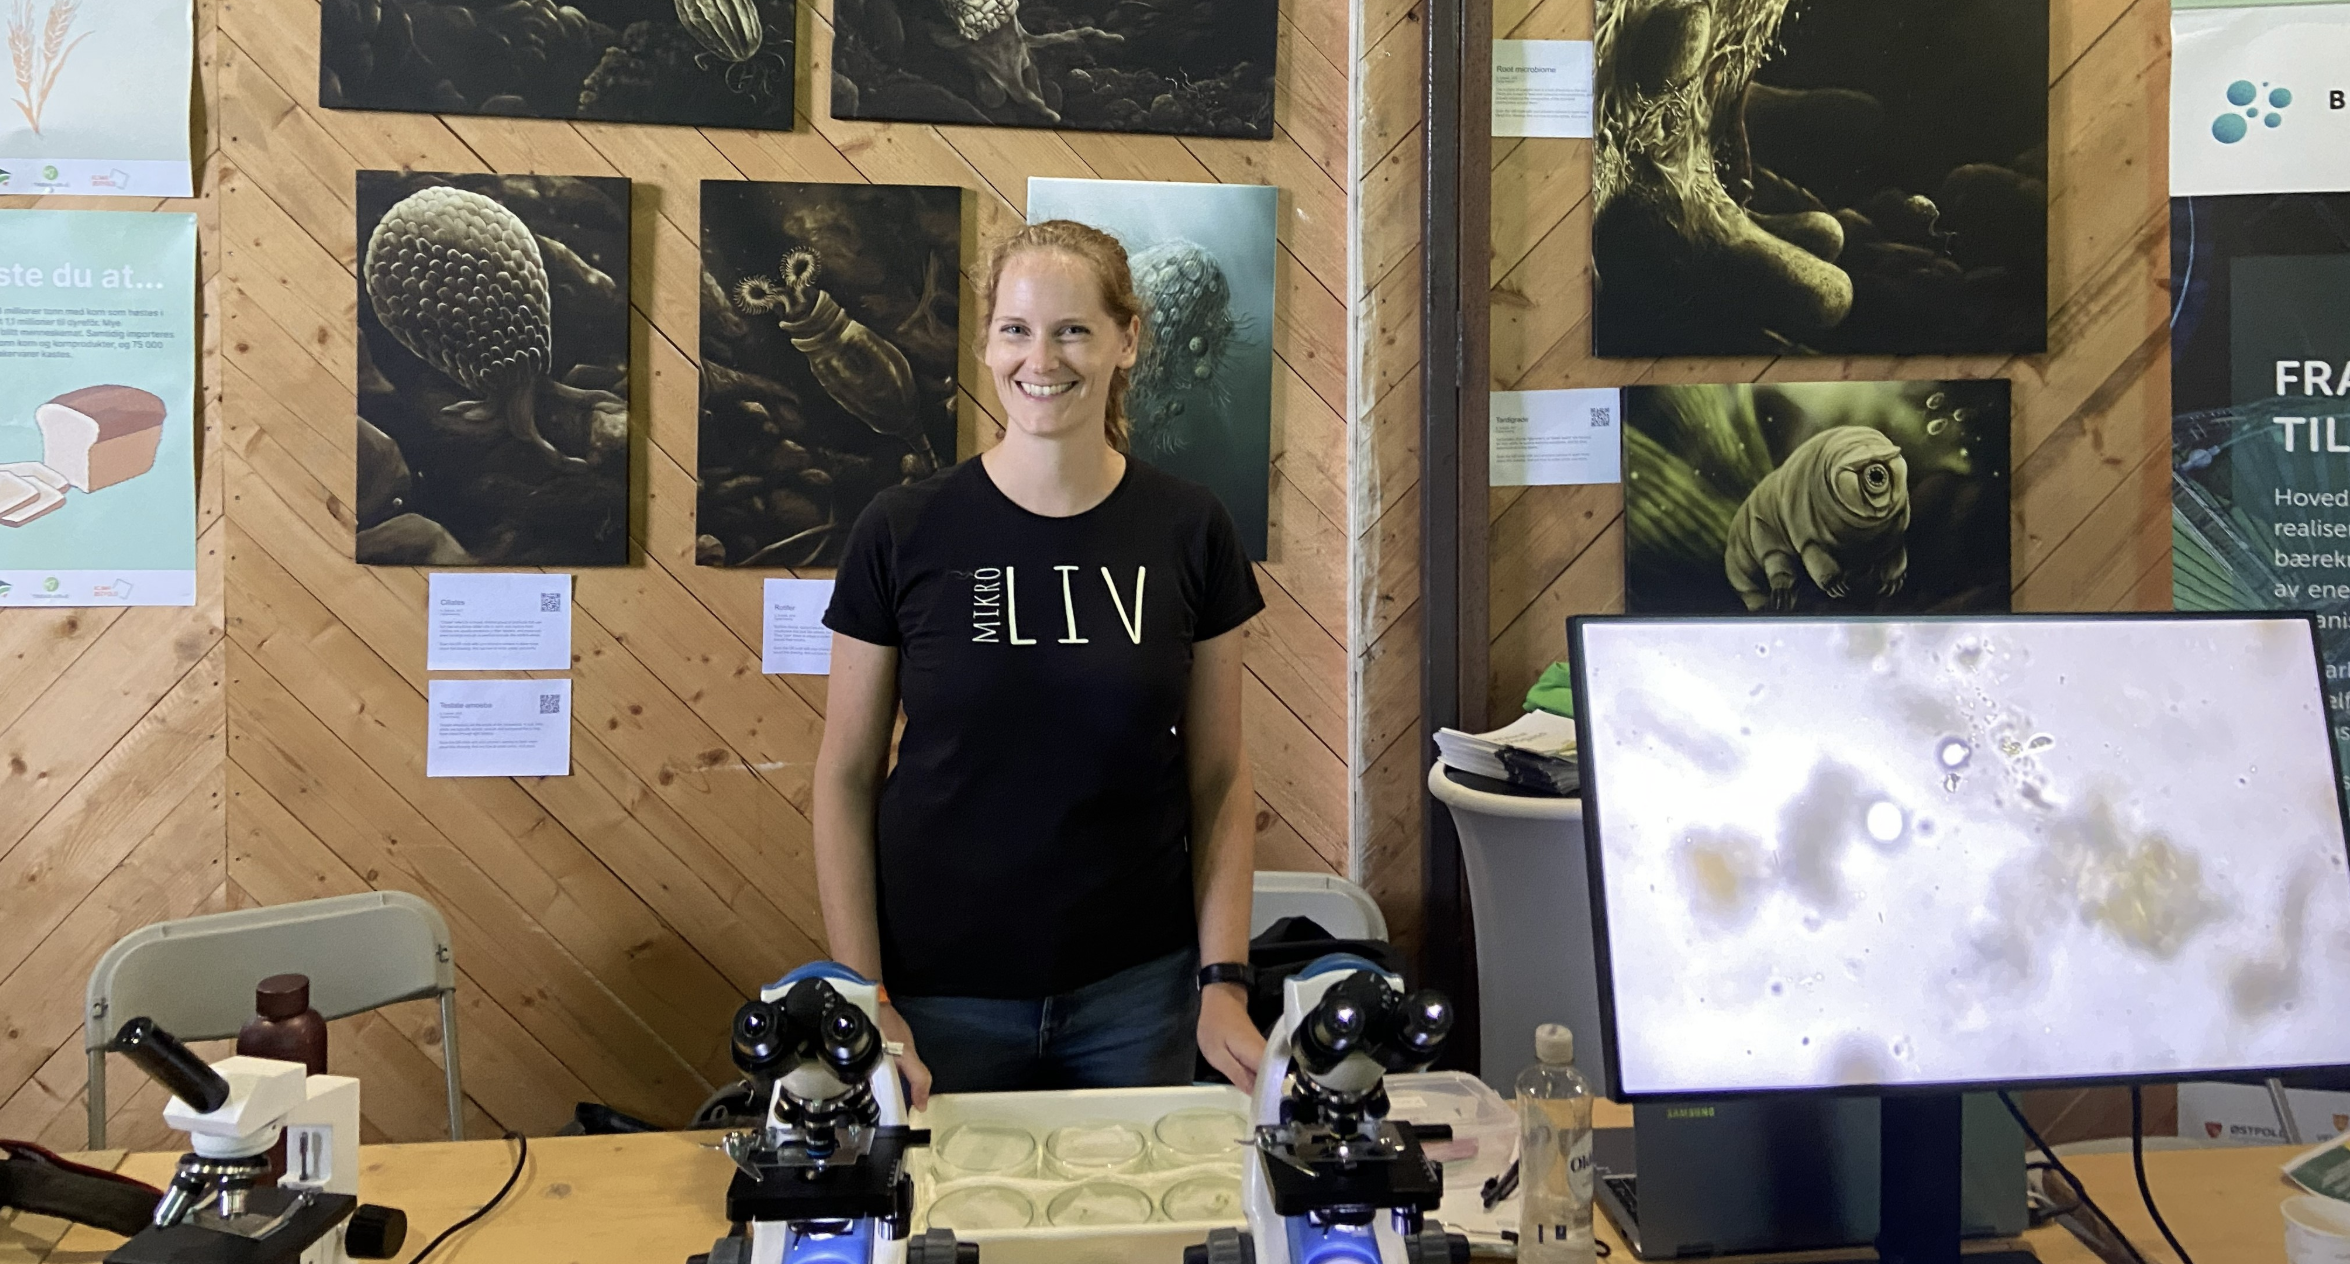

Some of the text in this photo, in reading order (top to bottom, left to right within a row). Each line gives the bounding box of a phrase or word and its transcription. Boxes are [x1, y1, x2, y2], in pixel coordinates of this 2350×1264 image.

[2329, 90, 2346, 109] B
[52, 262, 93, 288] du
[101, 264, 164, 289] at...
[2272, 416, 2350, 453] TIL
[2274, 519, 2350, 538] realise
[2274, 583, 2300, 599] av
[972, 567, 1001, 643] MIKRO
[1006, 566, 1146, 645] LIV
[1667, 1107, 1715, 1119] SAMSUNG
